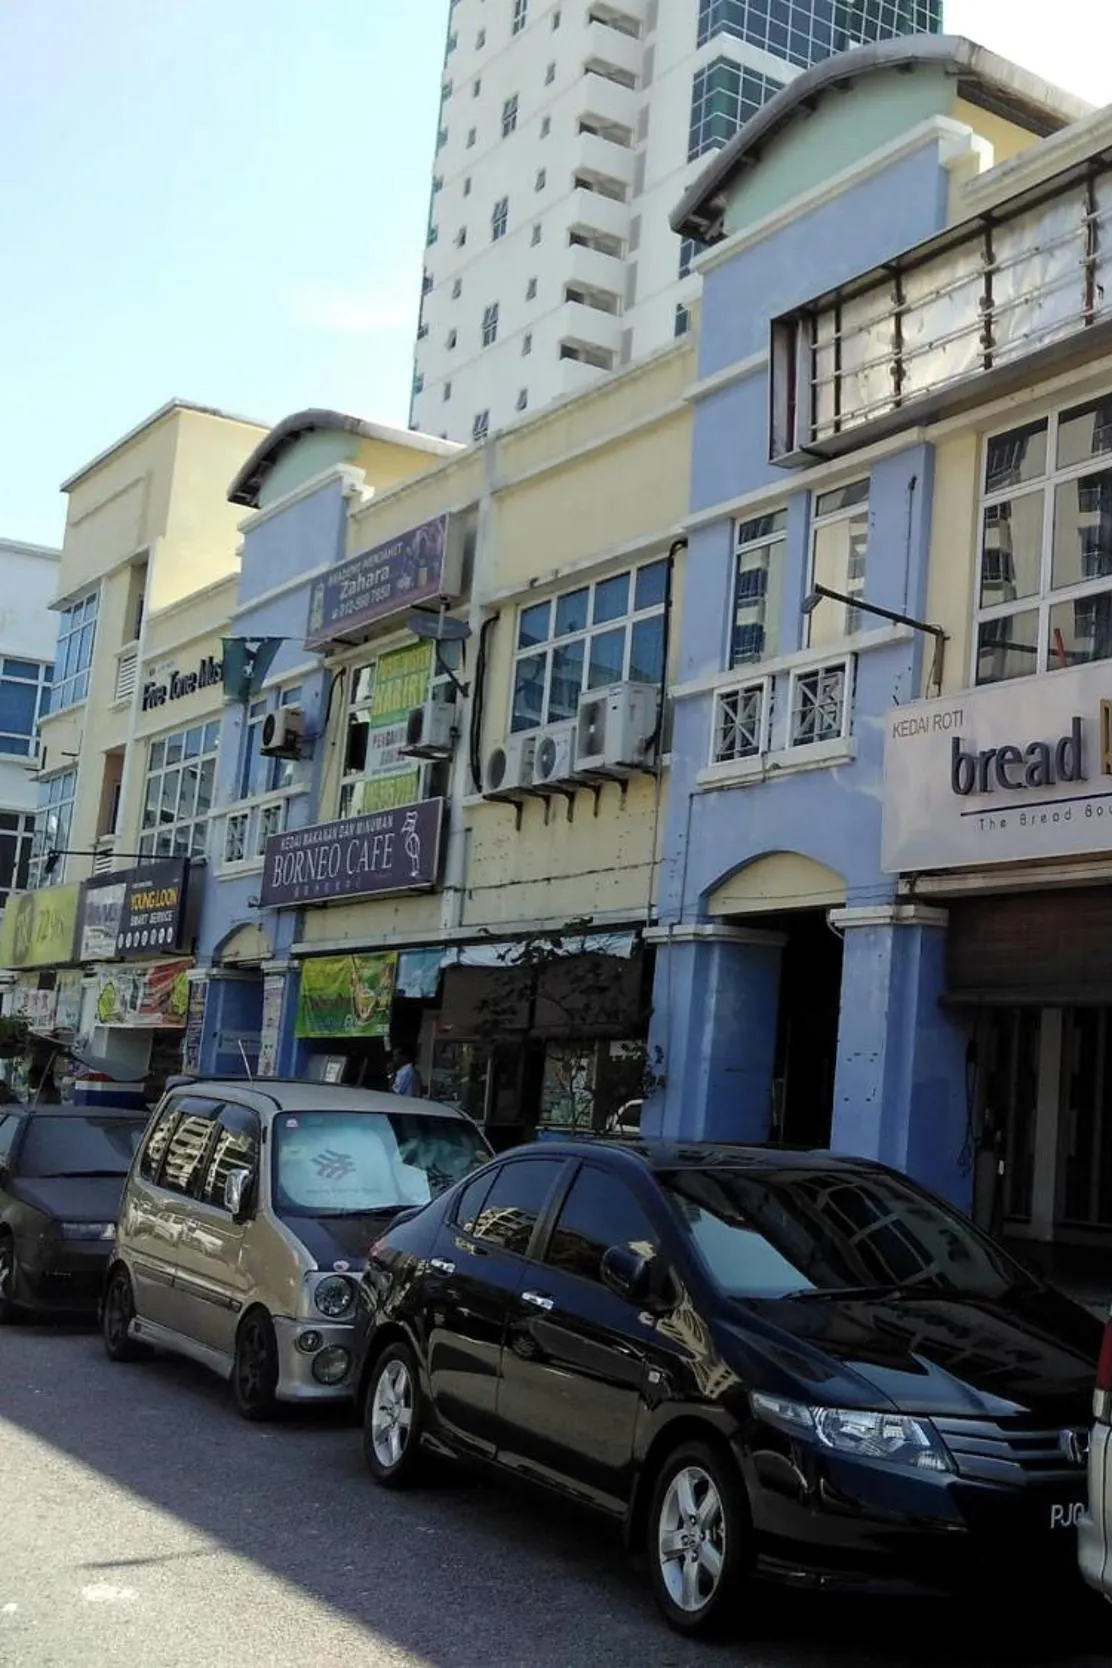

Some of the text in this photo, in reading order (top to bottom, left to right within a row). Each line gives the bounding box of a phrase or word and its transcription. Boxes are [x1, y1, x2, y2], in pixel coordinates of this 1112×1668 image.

[340, 566, 390, 599] Zahara
[892, 708, 963, 739] KEDAI ROTI
[951, 715, 1088, 797] bread
[978, 817, 1007, 832] The
[1019, 808, 1072, 827] Bread
[271, 842, 342, 888] BORNEO
[346, 832, 395, 875] CAFE
